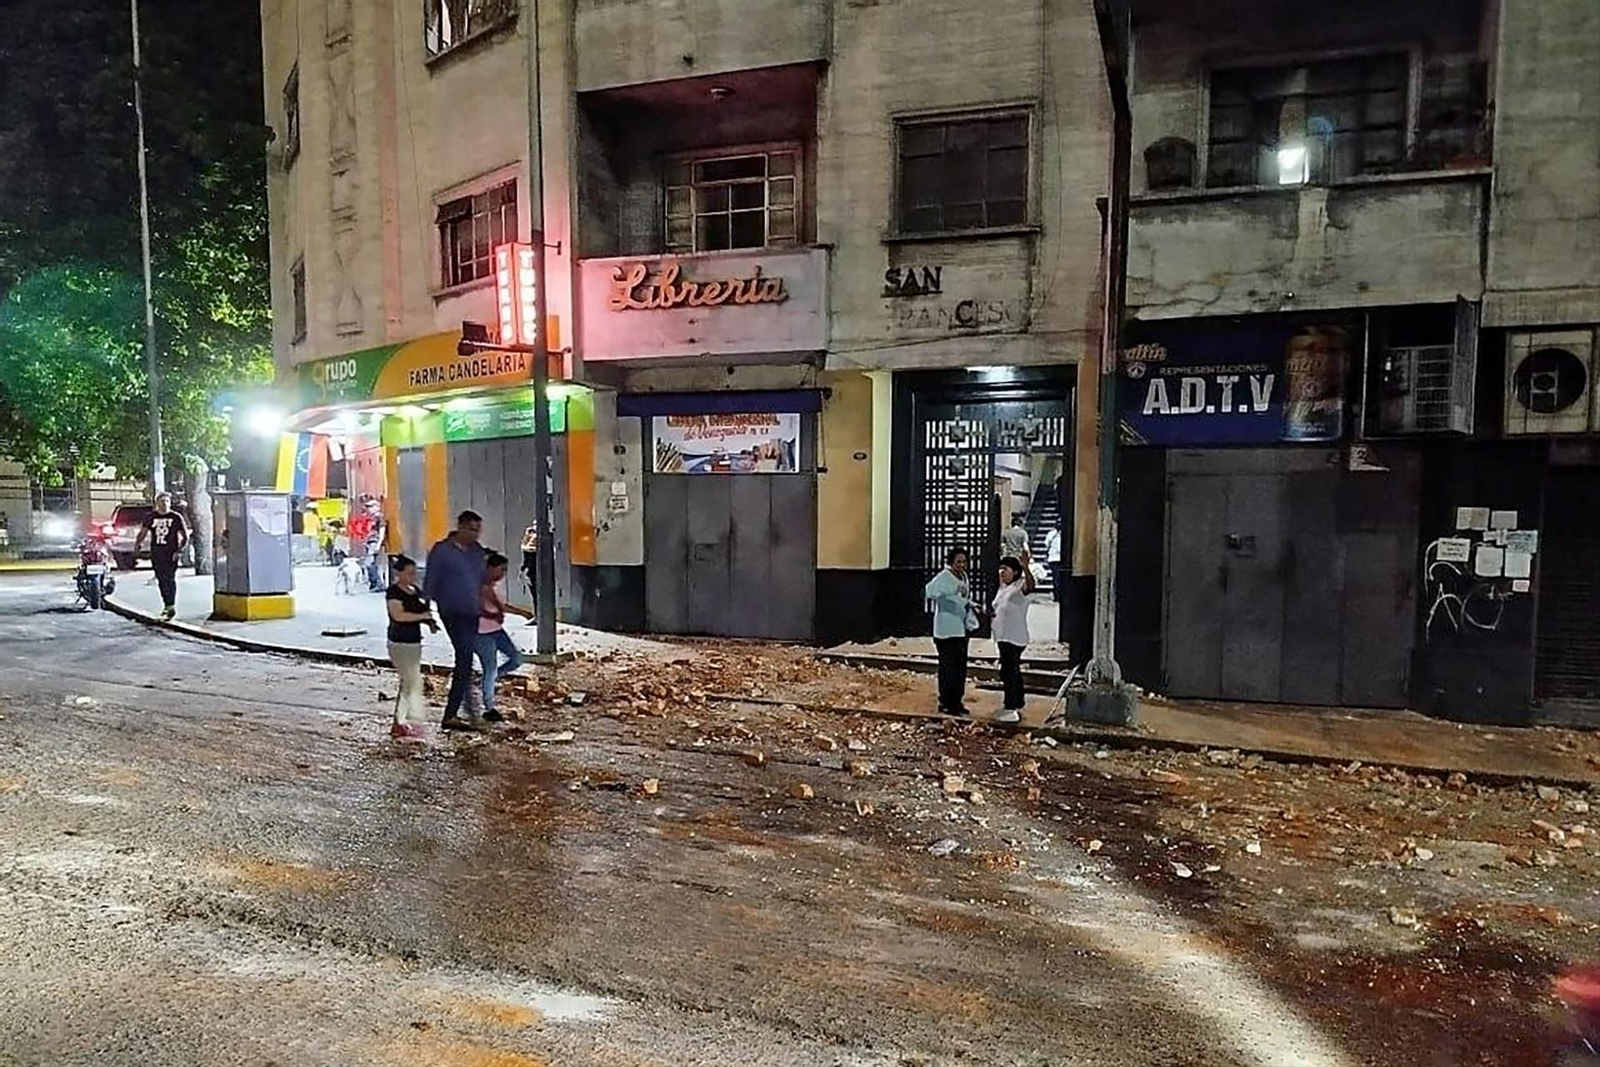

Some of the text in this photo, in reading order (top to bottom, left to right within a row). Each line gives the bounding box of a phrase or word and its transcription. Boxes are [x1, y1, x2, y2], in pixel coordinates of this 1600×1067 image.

[884, 266, 942, 296] SAN
[409, 353, 527, 388] FARMA CANDELARIA
